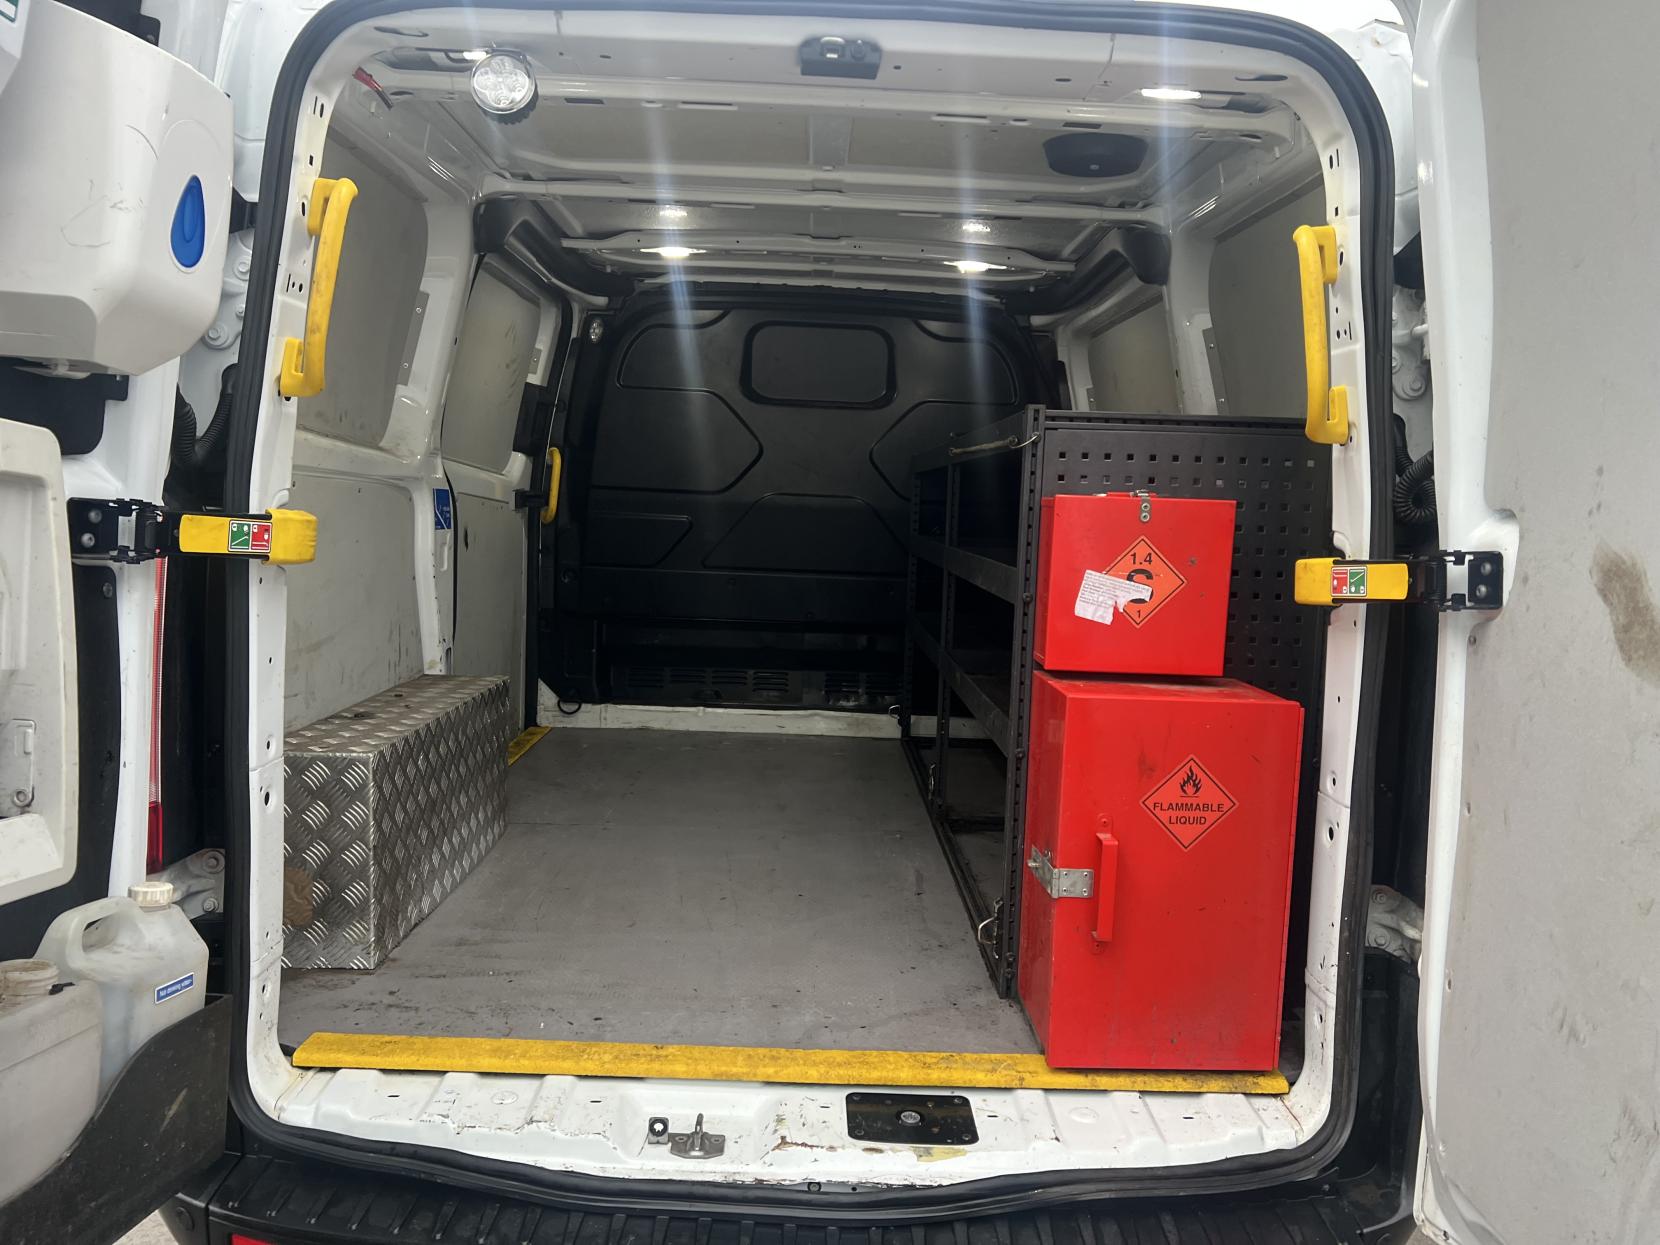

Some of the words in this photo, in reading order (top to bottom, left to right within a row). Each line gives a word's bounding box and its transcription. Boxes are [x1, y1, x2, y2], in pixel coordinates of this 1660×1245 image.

[1130, 552, 1152, 565] 1.4
[1136, 609, 1141, 619] 1
[1153, 802, 1225, 813] FLAMMABLE
[1168, 815, 1207, 826] LIQUID
